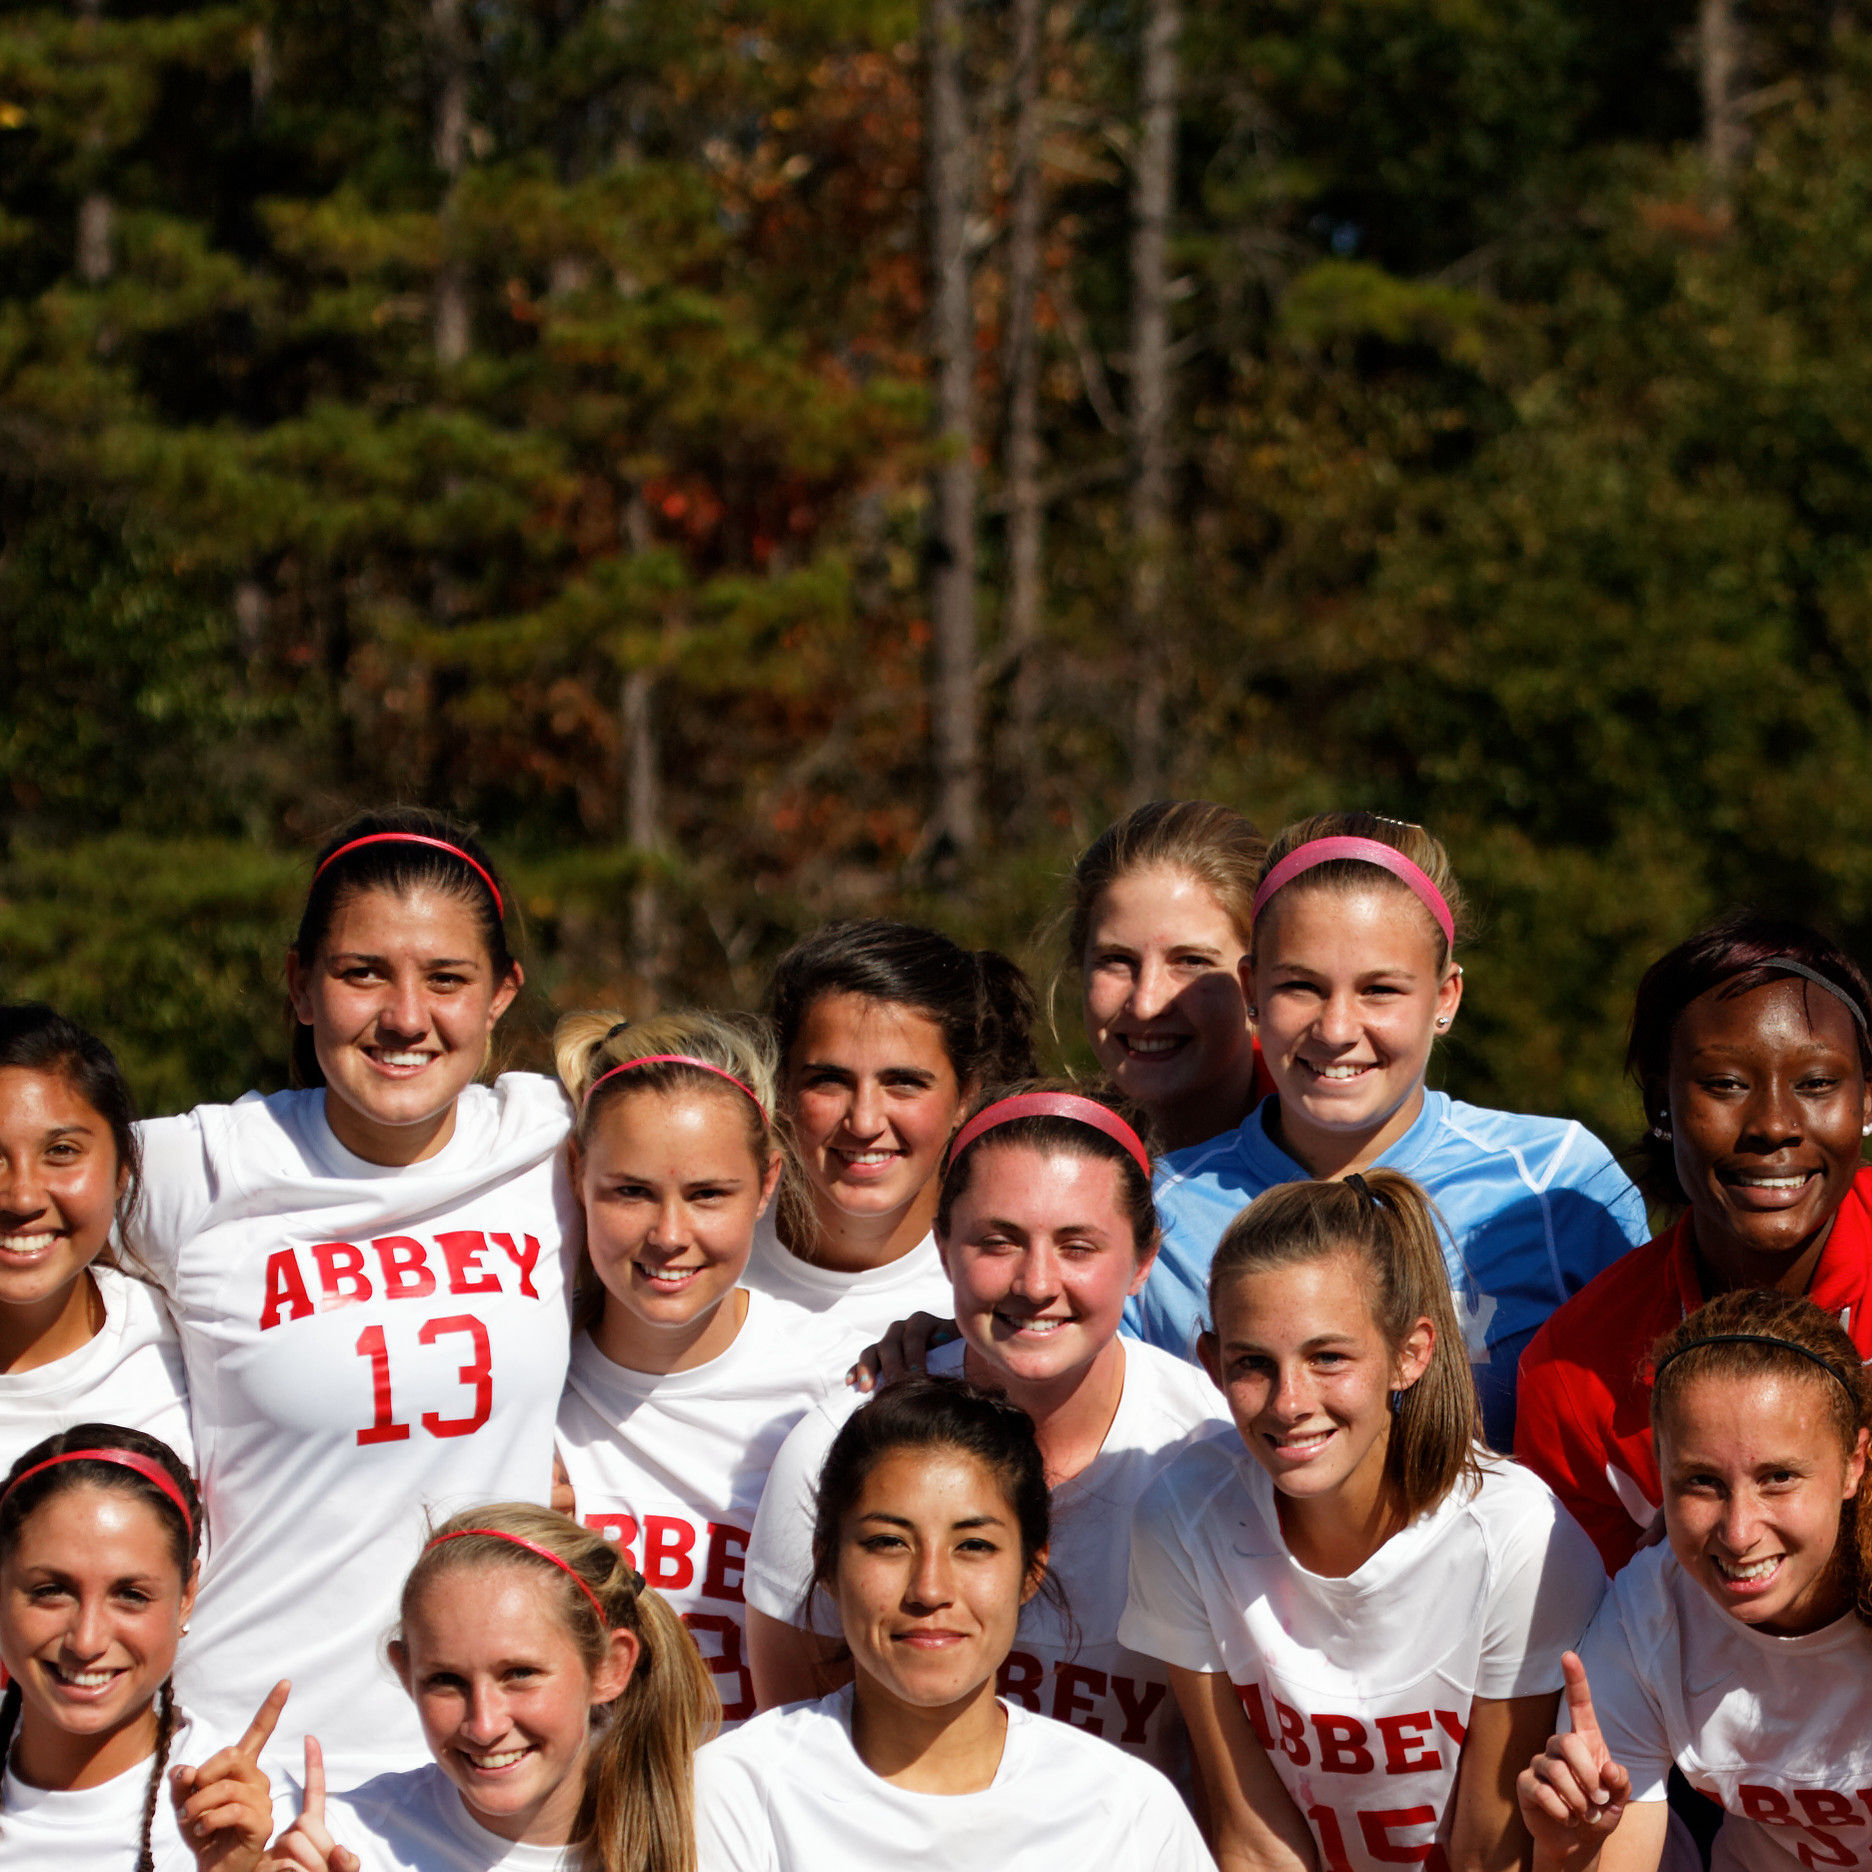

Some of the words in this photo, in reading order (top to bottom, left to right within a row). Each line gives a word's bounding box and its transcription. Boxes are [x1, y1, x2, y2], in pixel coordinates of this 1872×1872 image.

[259, 1230, 542, 1332] ABBEY
[354, 1313, 494, 1447] 13
[584, 1512, 752, 1604] BBE
[996, 1650, 1167, 1745] BEY
